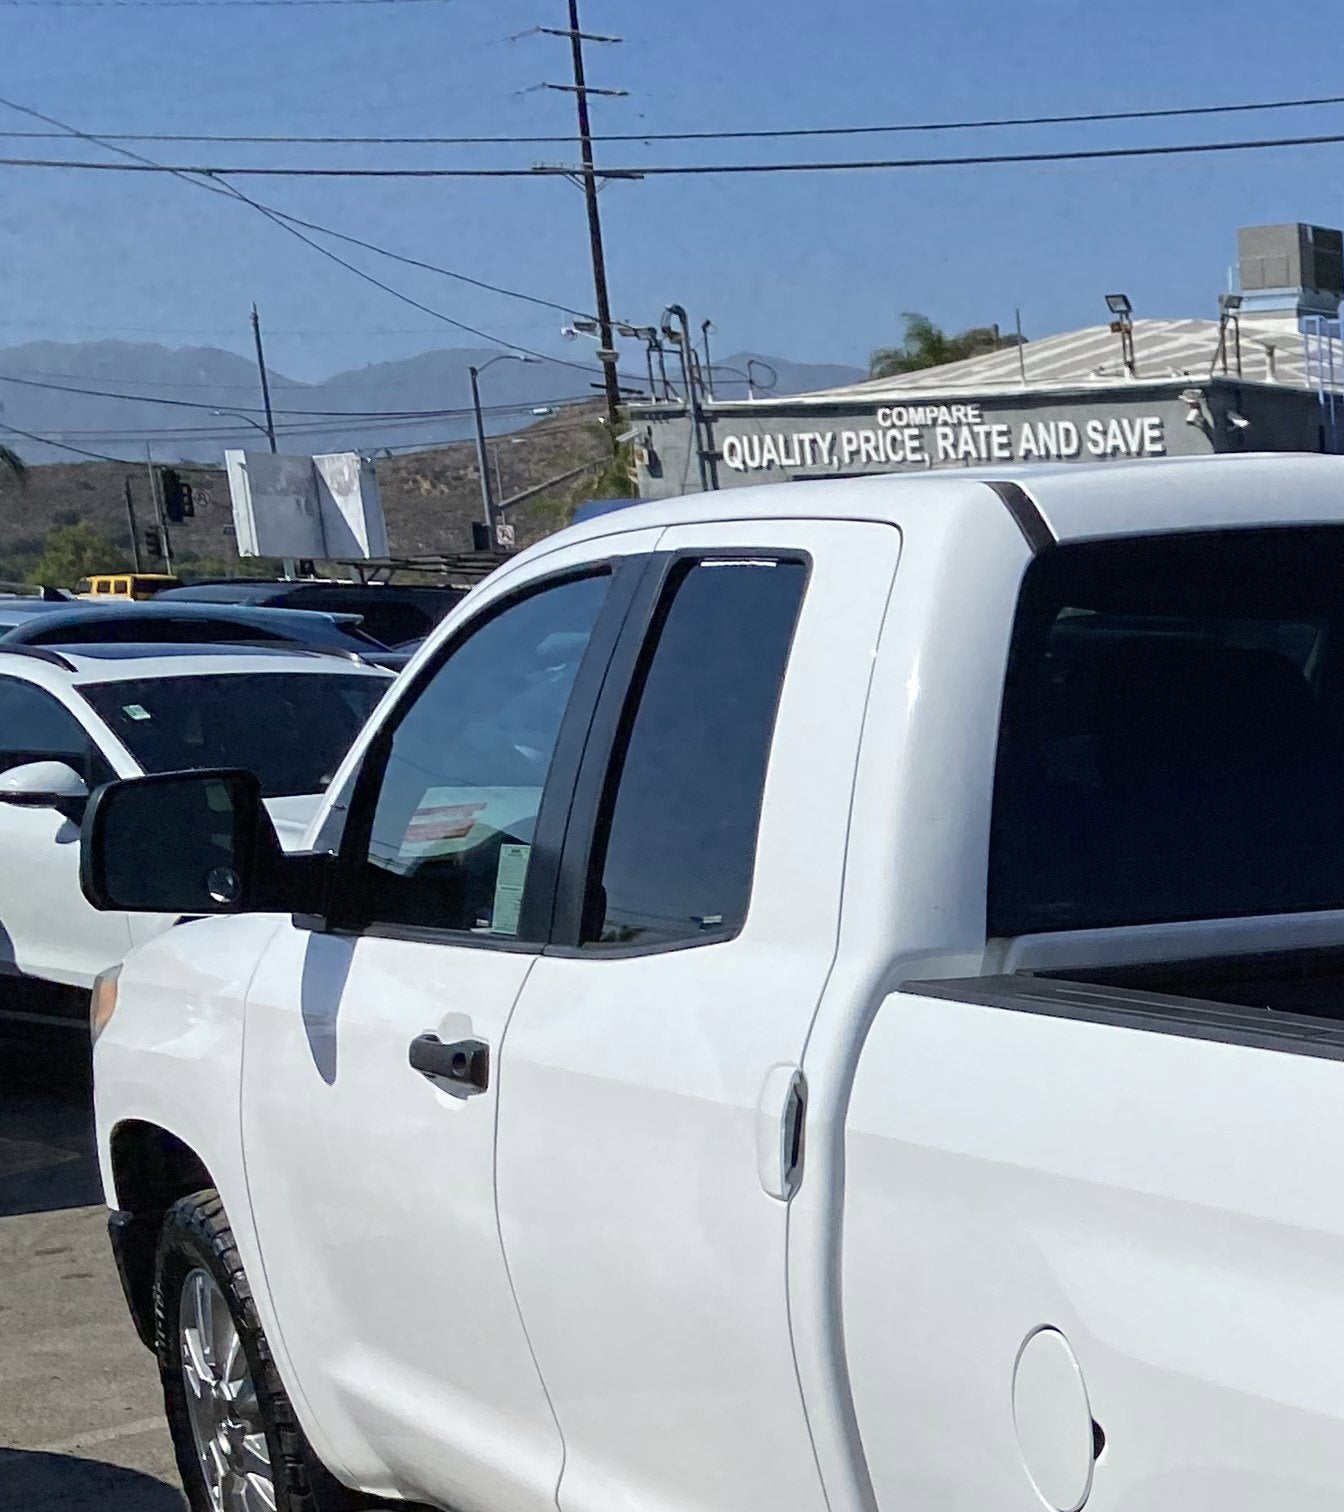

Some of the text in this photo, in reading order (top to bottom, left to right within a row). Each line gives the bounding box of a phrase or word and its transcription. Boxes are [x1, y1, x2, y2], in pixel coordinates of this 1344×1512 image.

[877, 404, 981, 427] COMPARE
[723, 417, 1163, 470] QUALITY, PRICE, RATE AND SAVE
